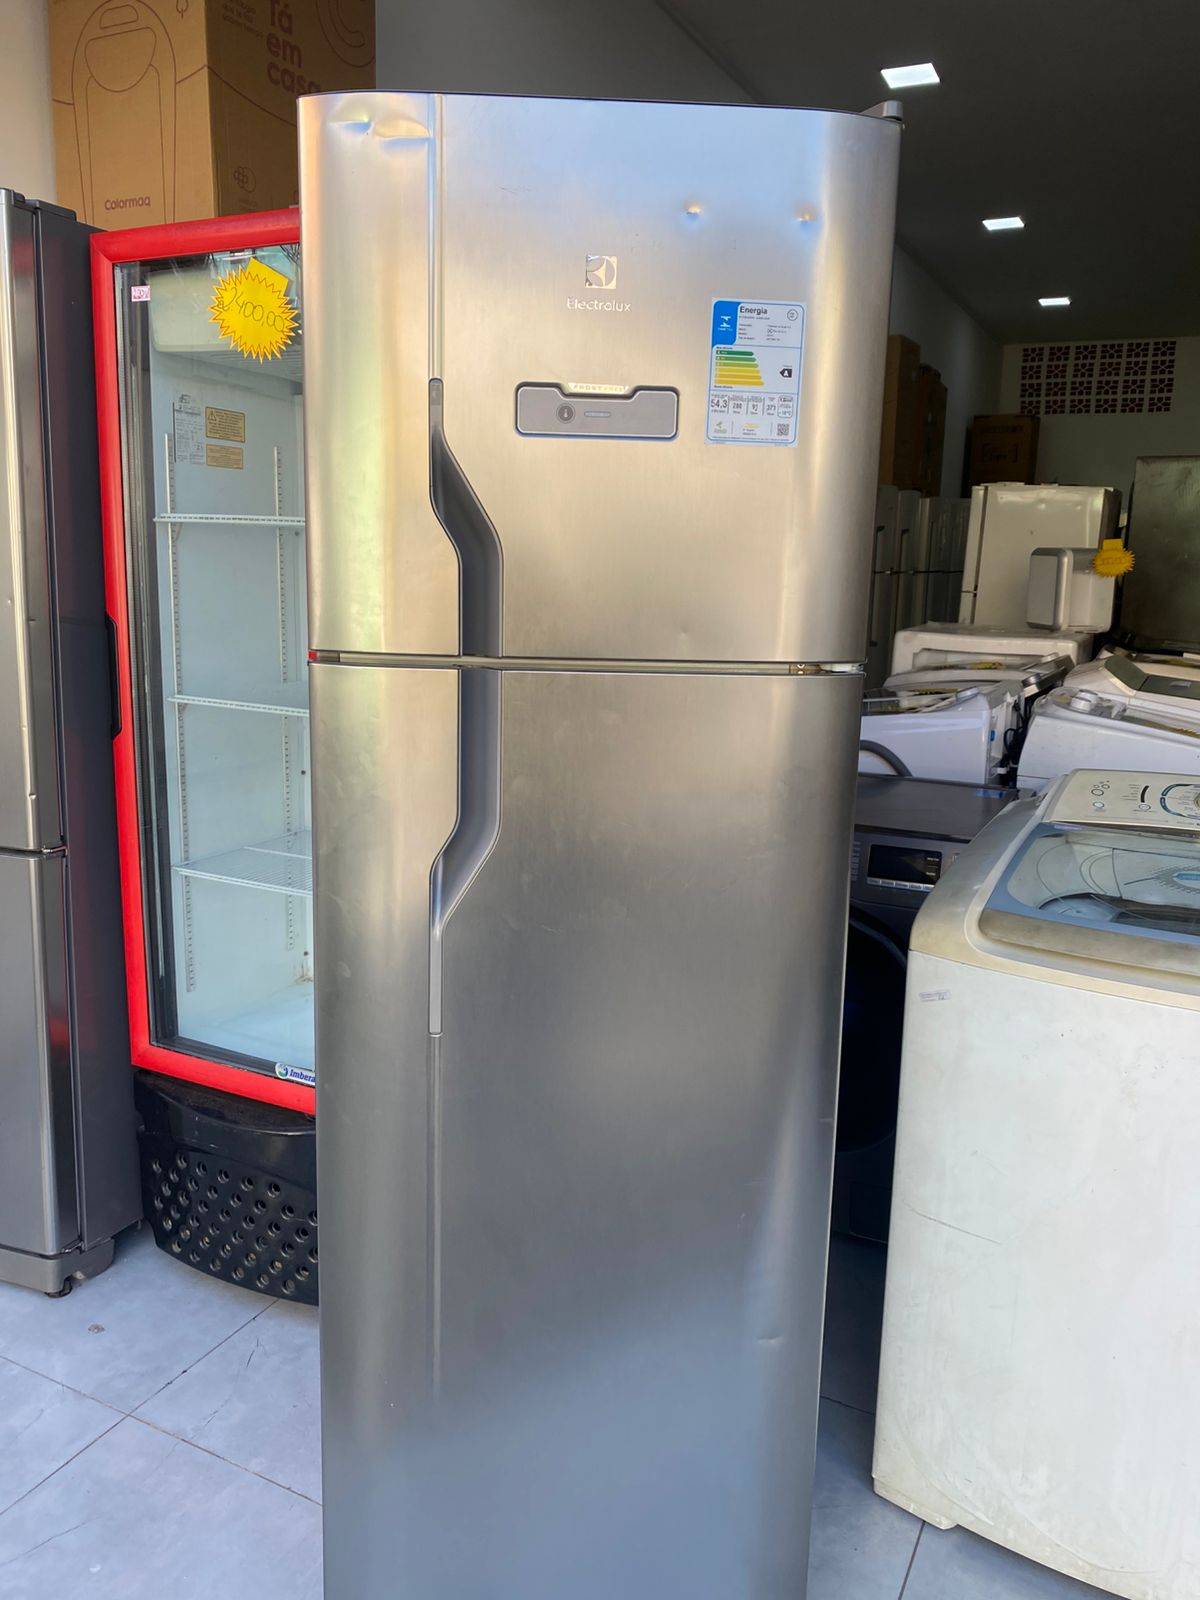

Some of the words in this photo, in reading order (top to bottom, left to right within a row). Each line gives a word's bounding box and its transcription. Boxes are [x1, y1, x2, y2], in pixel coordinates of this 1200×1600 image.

[266, 32, 302, 68] em
[104, 196, 151, 211] Colormaq
[566, 297, 633, 312] Electrolux
[740, 305, 768, 316] Energia
